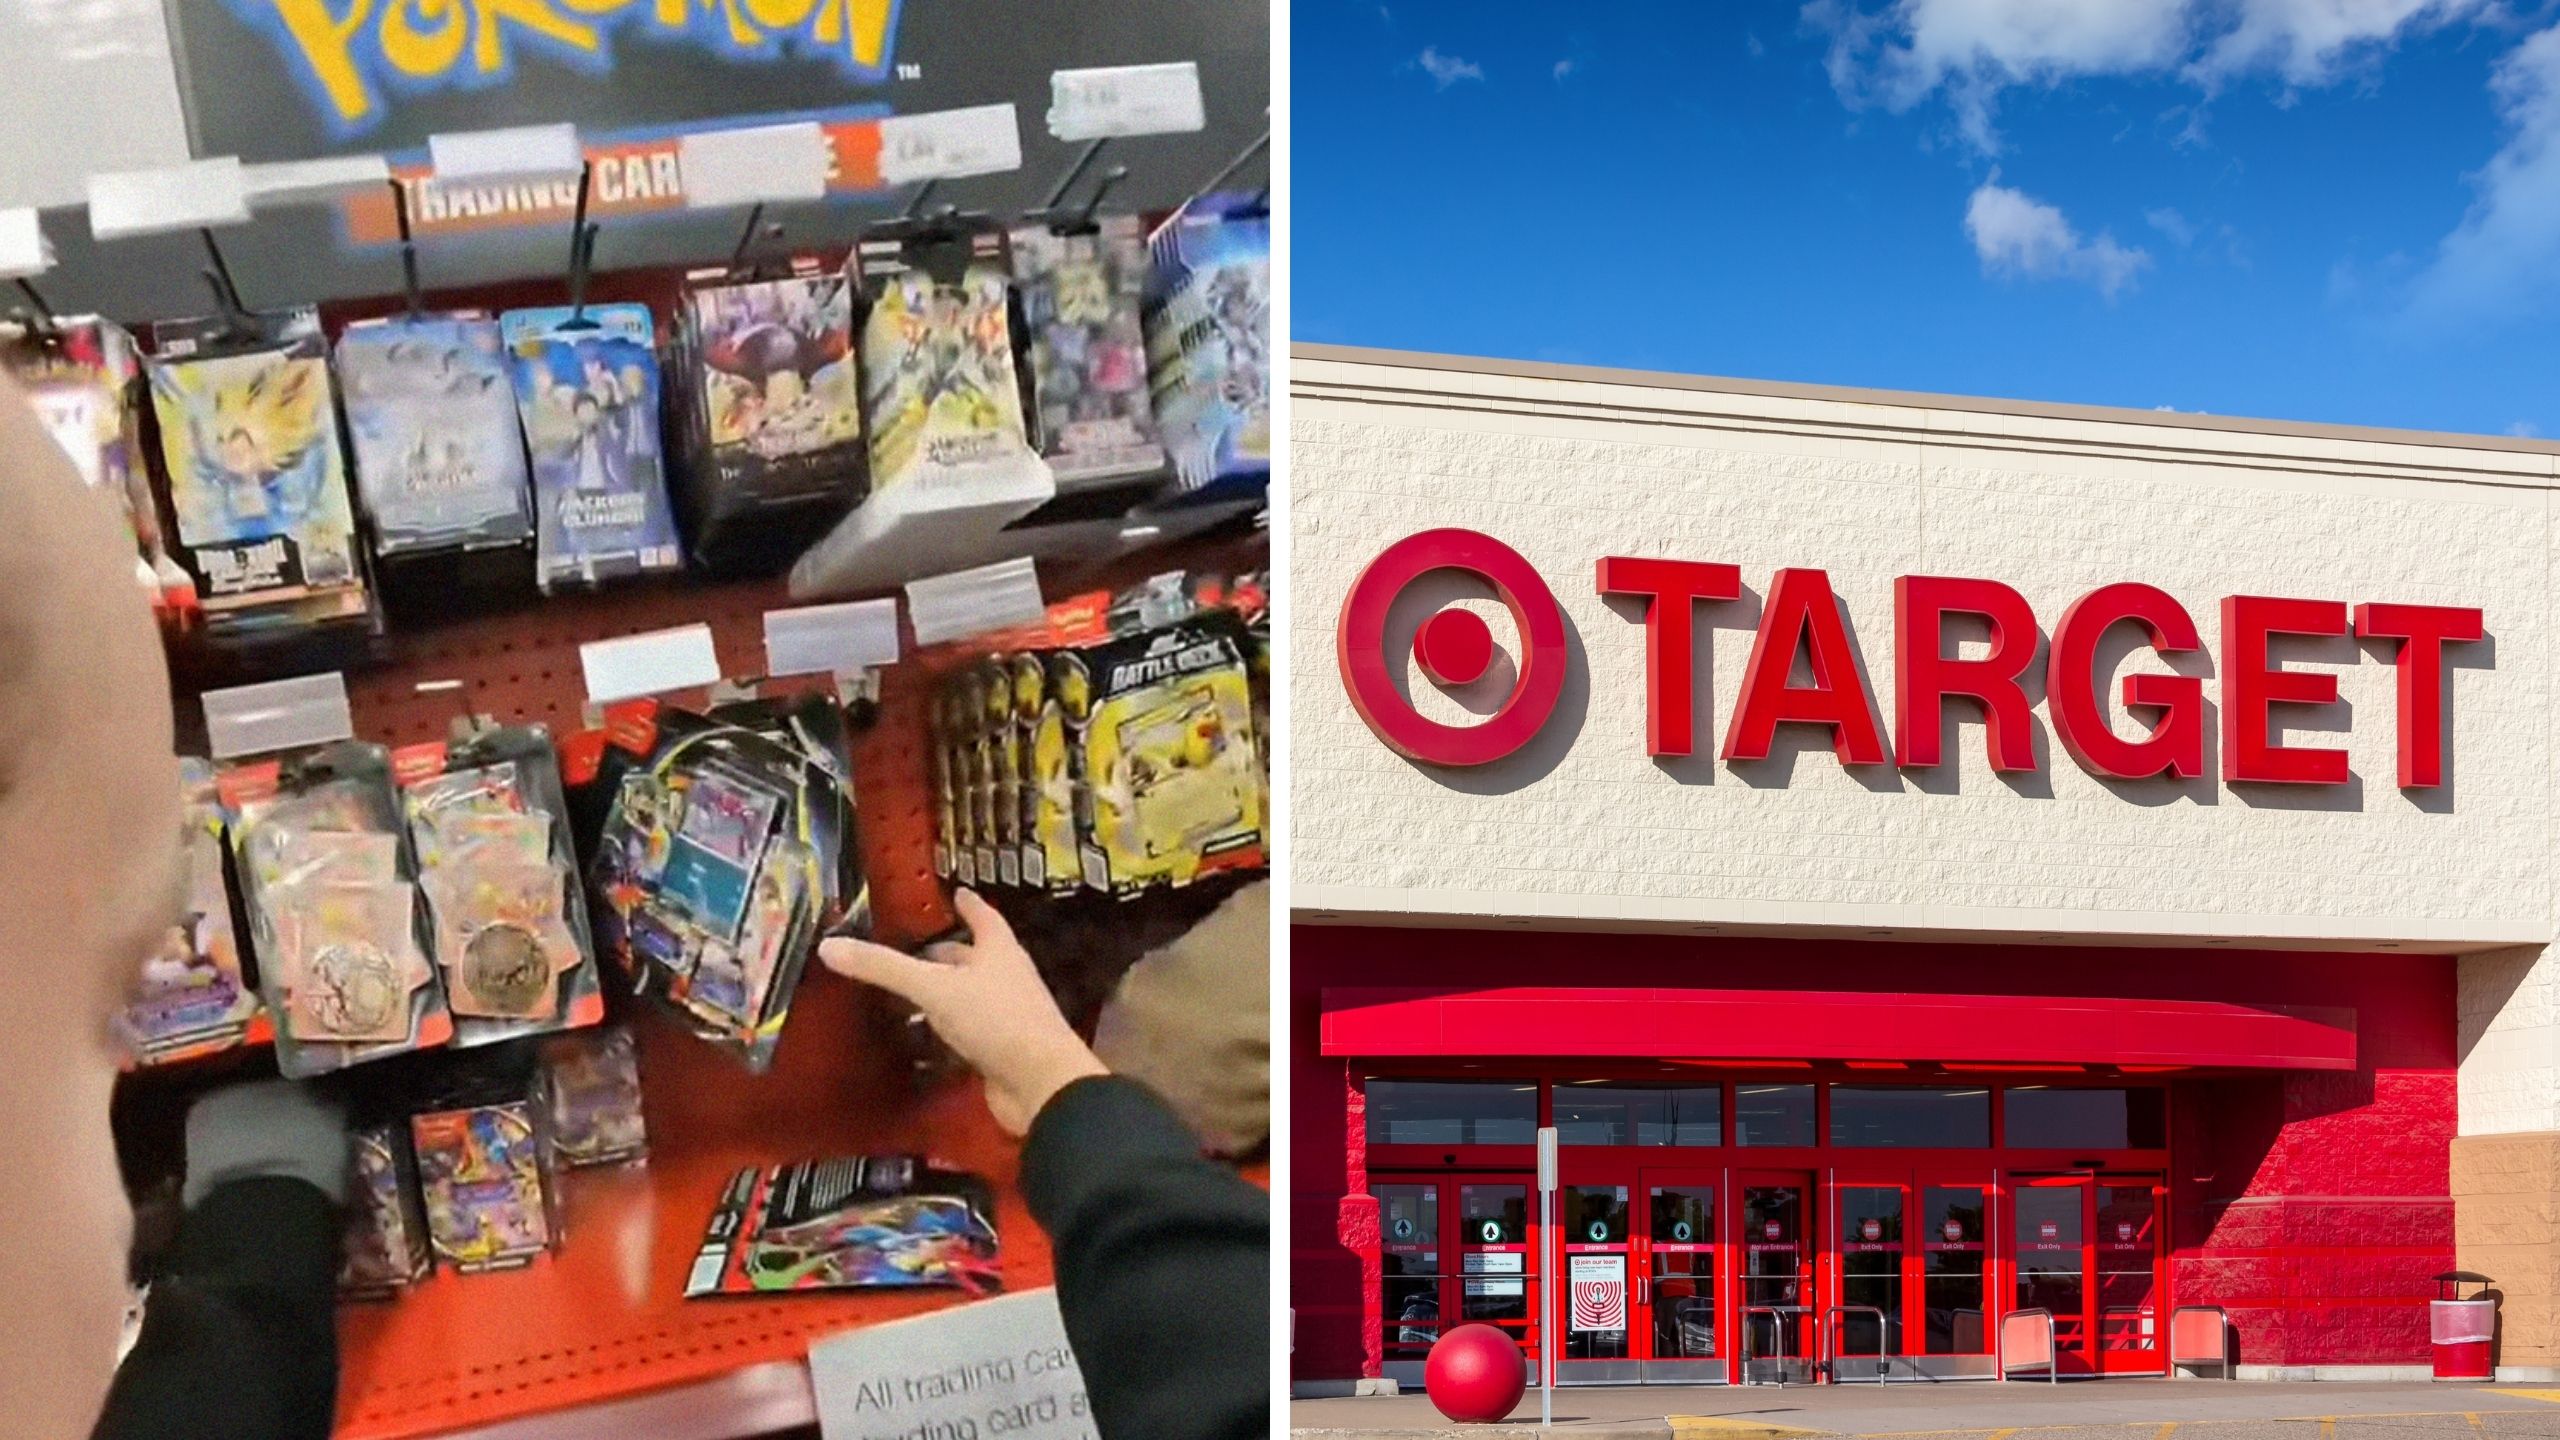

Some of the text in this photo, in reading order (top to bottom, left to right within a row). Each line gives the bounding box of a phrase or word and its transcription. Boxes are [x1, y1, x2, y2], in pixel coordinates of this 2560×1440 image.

[897, 63, 922, 80] TM
[1111, 655, 1176, 693] BATTLE
[1596, 556, 2483, 789] TARGET
[855, 1379, 893, 1412] All
[904, 1356, 1016, 1402] trading
[987, 1394, 1058, 1434] card
